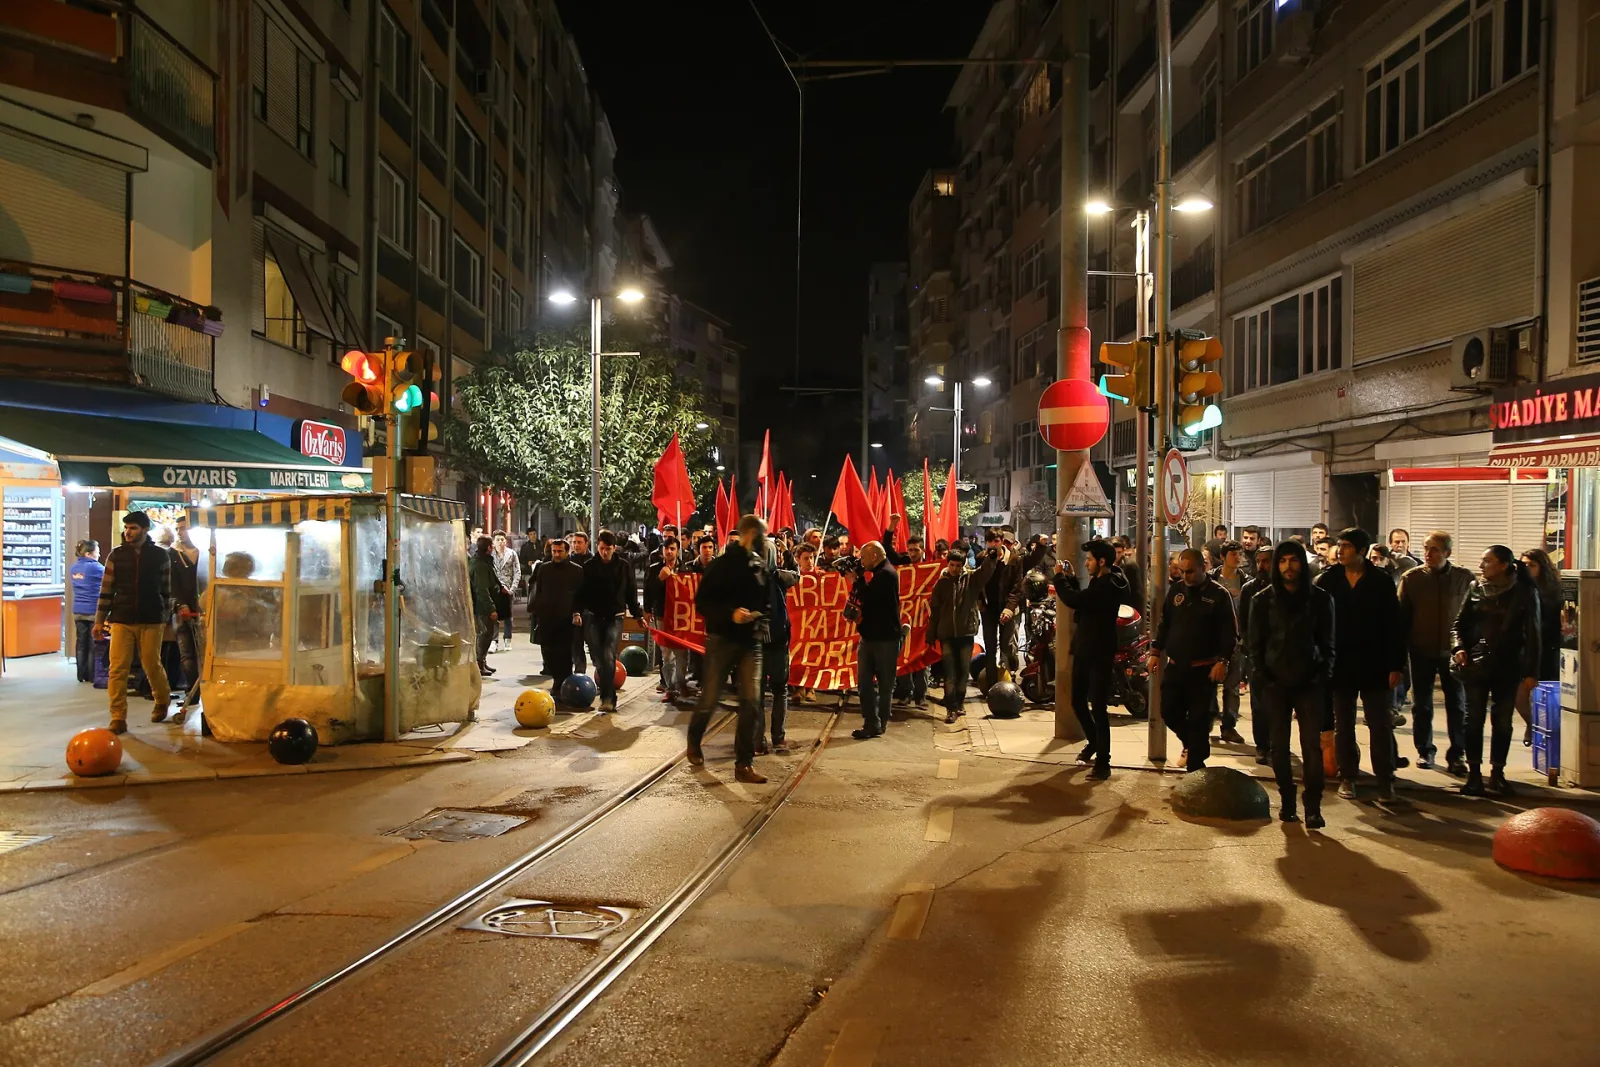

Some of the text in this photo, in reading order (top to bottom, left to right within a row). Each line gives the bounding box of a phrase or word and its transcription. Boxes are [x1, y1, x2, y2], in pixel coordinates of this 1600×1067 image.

[1488, 389, 1568, 430] SUADİYE
[162, 467, 329, 488] ÖZVARİŞ MARKETLERİ
